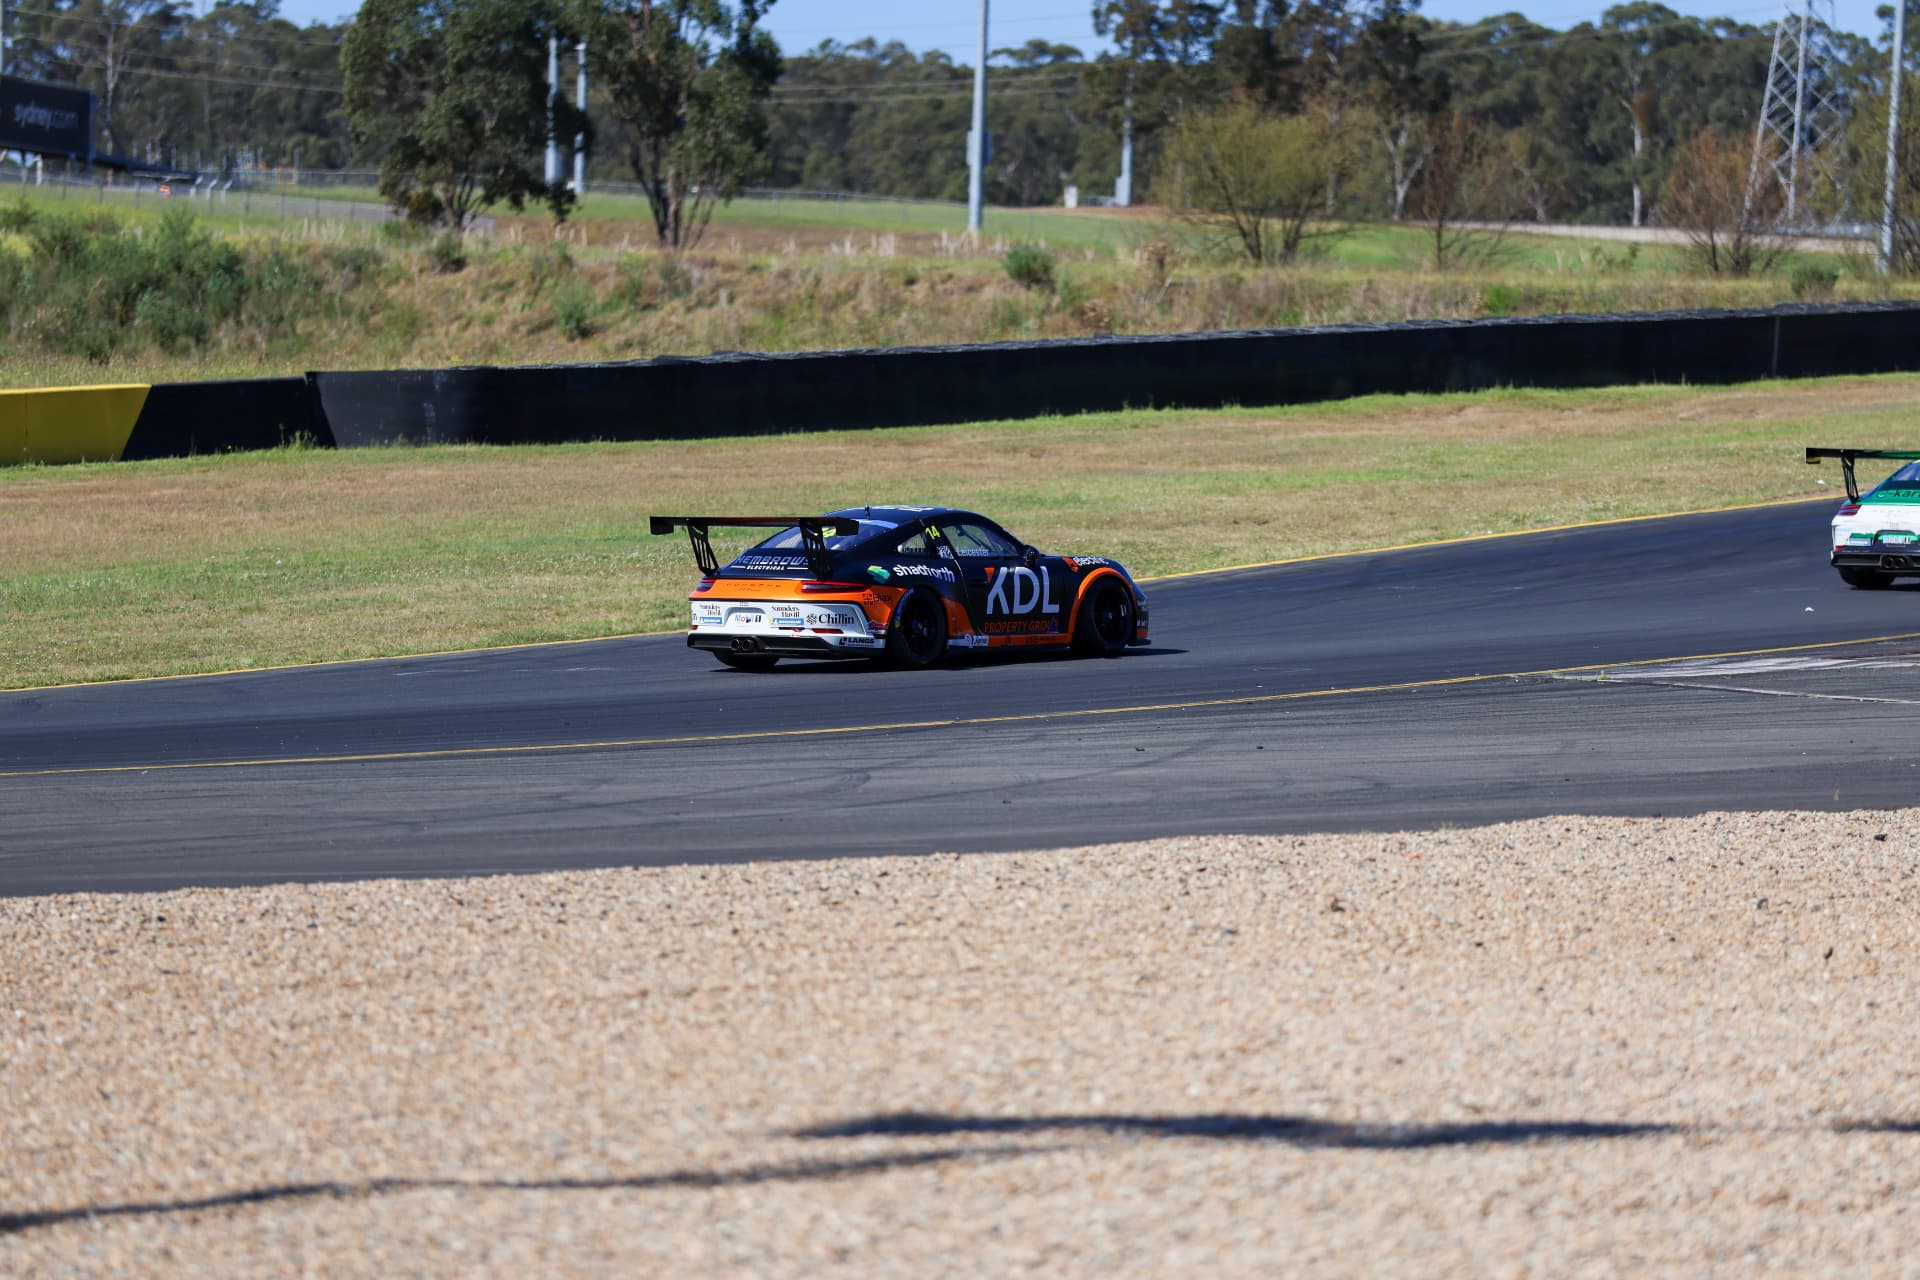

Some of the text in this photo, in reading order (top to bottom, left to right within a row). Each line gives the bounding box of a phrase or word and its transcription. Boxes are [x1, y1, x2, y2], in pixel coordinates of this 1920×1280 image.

[925, 525, 941, 540] 14
[893, 564, 955, 583] shadforth
[985, 566, 1060, 615] KDL
[818, 613, 855, 625] Chillin
[984, 620, 1027, 633] PROPERTY
